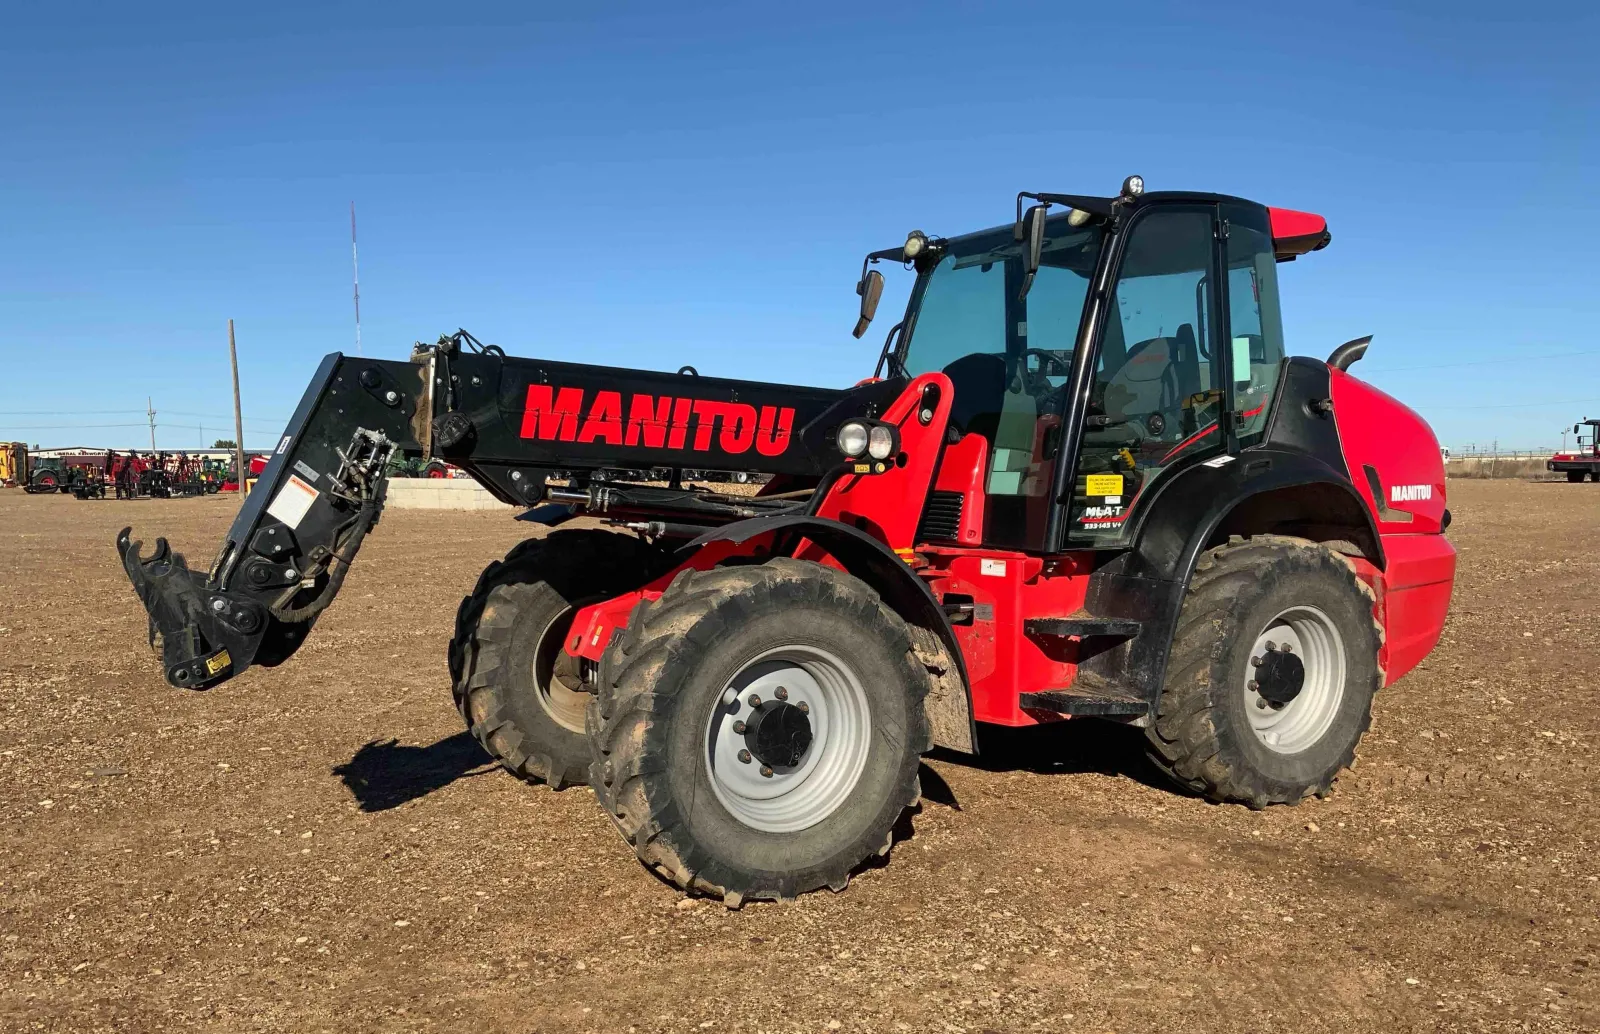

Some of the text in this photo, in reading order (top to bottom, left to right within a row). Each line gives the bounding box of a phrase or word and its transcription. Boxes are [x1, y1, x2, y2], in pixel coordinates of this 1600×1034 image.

[520, 384, 795, 457] MANITOU
[1392, 484, 1432, 502] MANITOU
[1086, 506, 1122, 516] MLA-T
